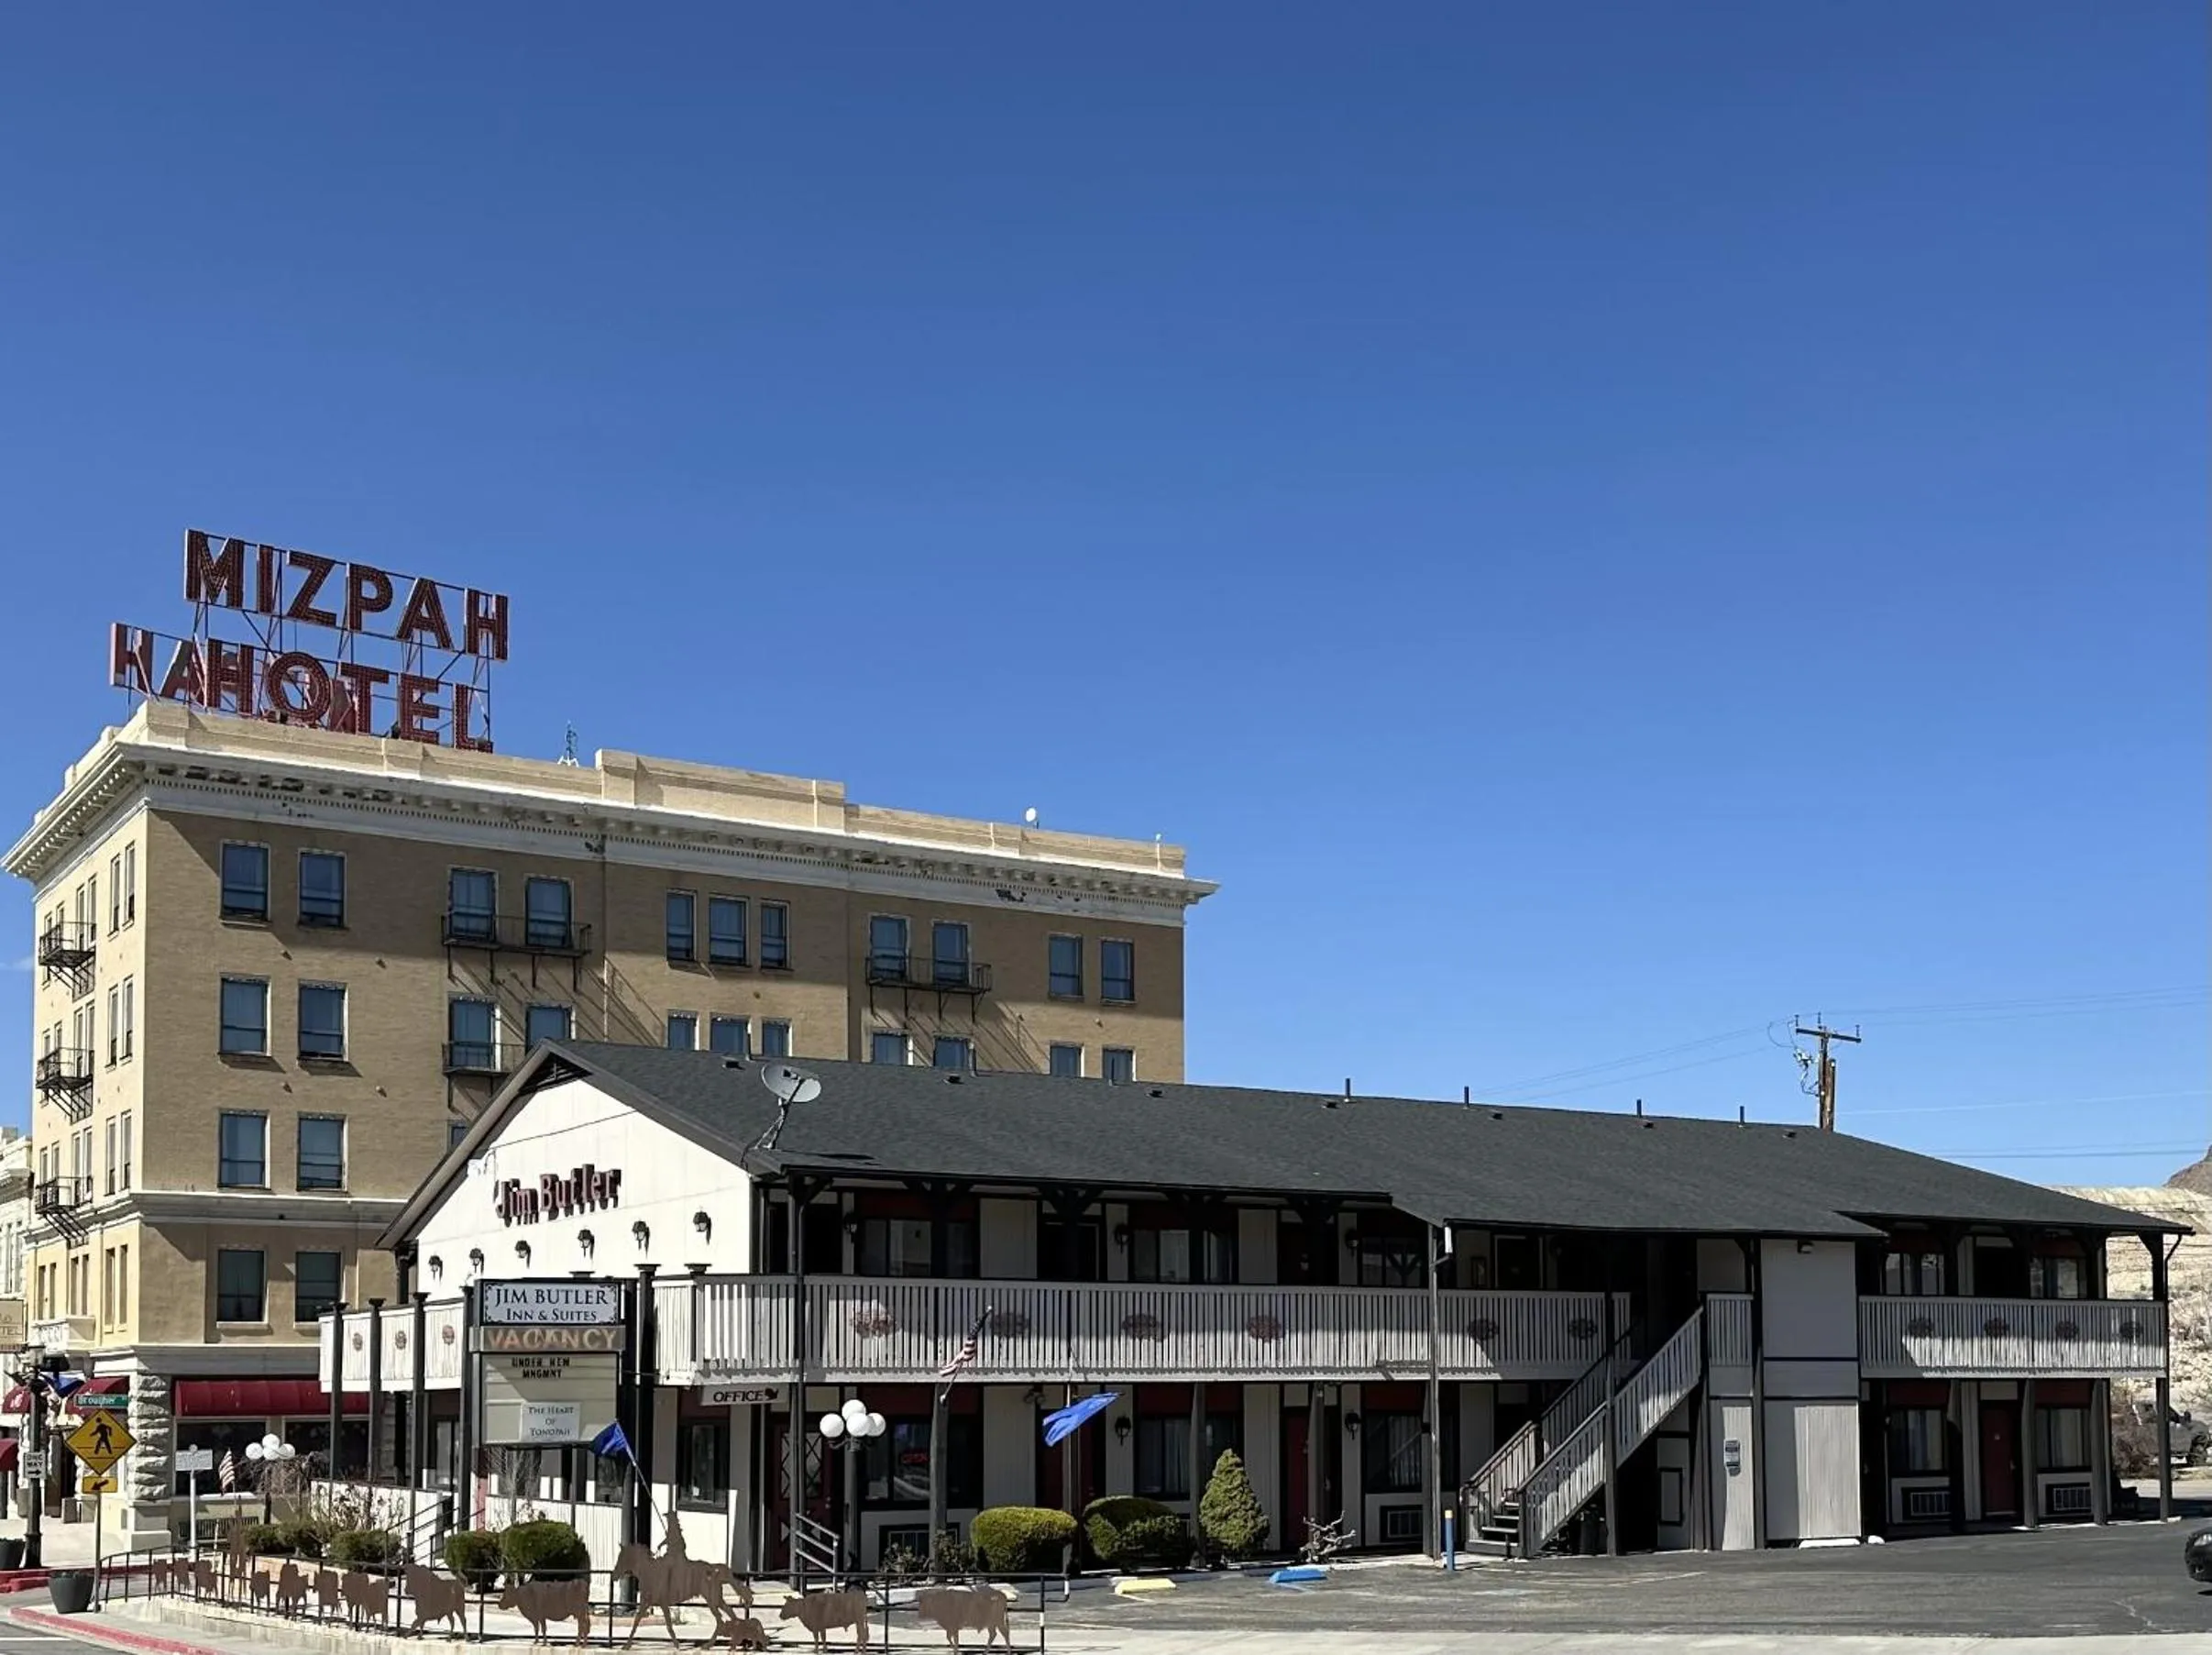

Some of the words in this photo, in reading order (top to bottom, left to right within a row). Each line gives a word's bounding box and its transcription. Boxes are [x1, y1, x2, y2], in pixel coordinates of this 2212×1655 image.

[184, 528, 509, 661] MIZPAH
[204, 638, 494, 755] HOTEL
[495, 1178, 539, 1219] Jim
[539, 1164, 622, 1212] Butler
[495, 1288, 528, 1307] JIM
[534, 1288, 609, 1306] BUTLER
[506, 1308, 534, 1321] INN
[537, 1309, 548, 1321] &
[552, 1308, 598, 1321] SUITES
[488, 1329, 617, 1351] VACANCY
[512, 1357, 543, 1368] UNDER
[713, 1390, 764, 1403] OFFICE
